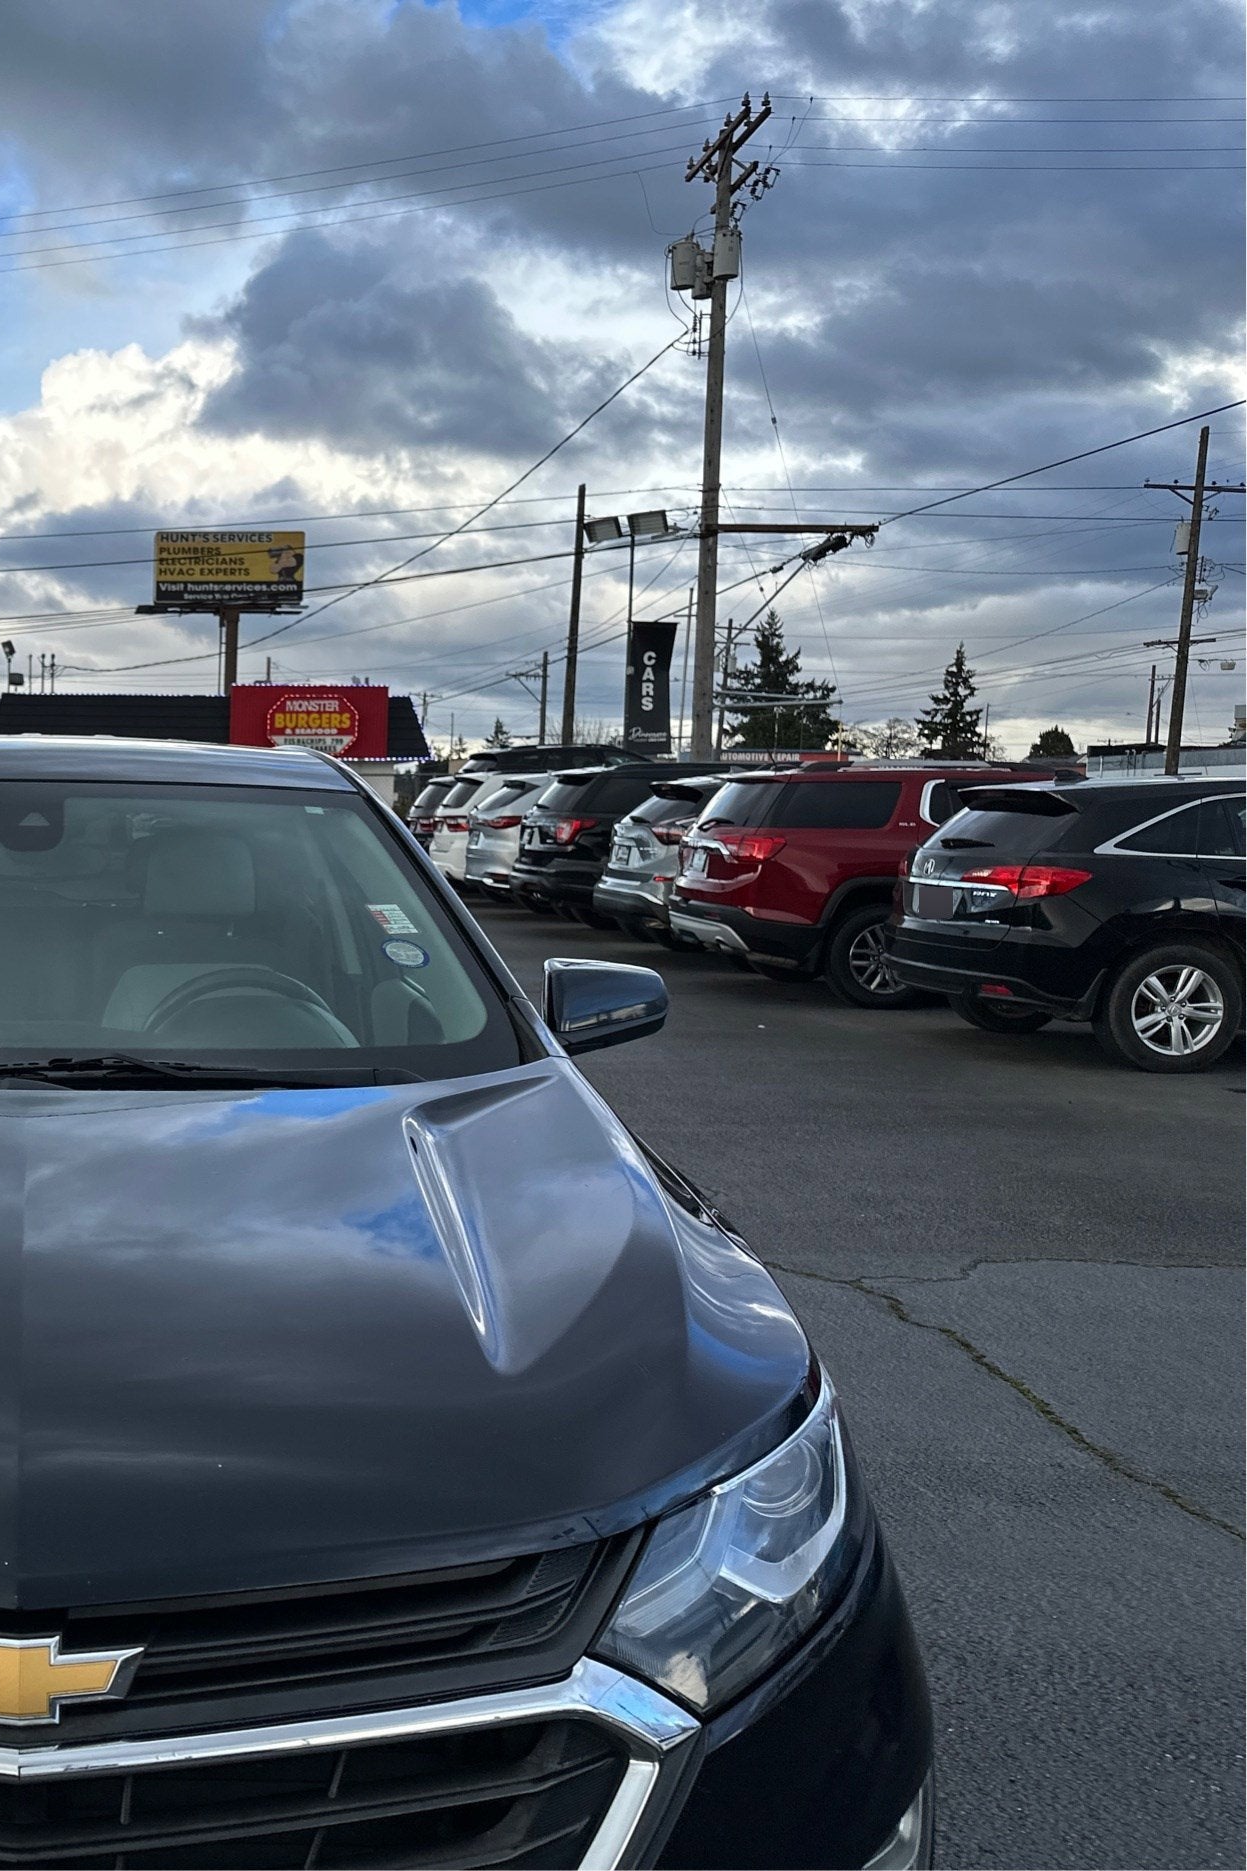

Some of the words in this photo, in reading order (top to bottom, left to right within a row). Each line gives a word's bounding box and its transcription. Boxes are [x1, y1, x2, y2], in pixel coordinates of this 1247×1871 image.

[160, 533, 210, 543] HUNT'S
[212, 533, 273, 543] SERVICES
[159, 546, 222, 556] PLUMBERS
[158, 557, 246, 566] ELECTRICIANS
[159, 567, 195, 577] HVAC
[199, 567, 251, 577] EXPERTS
[159, 583, 184, 591] Visit
[641, 651, 657, 711] CARS
[285, 700, 340, 712] MONSTER
[273, 712, 352, 729] BURGERS
[720, 752, 770, 762] UTOMOTIVE
